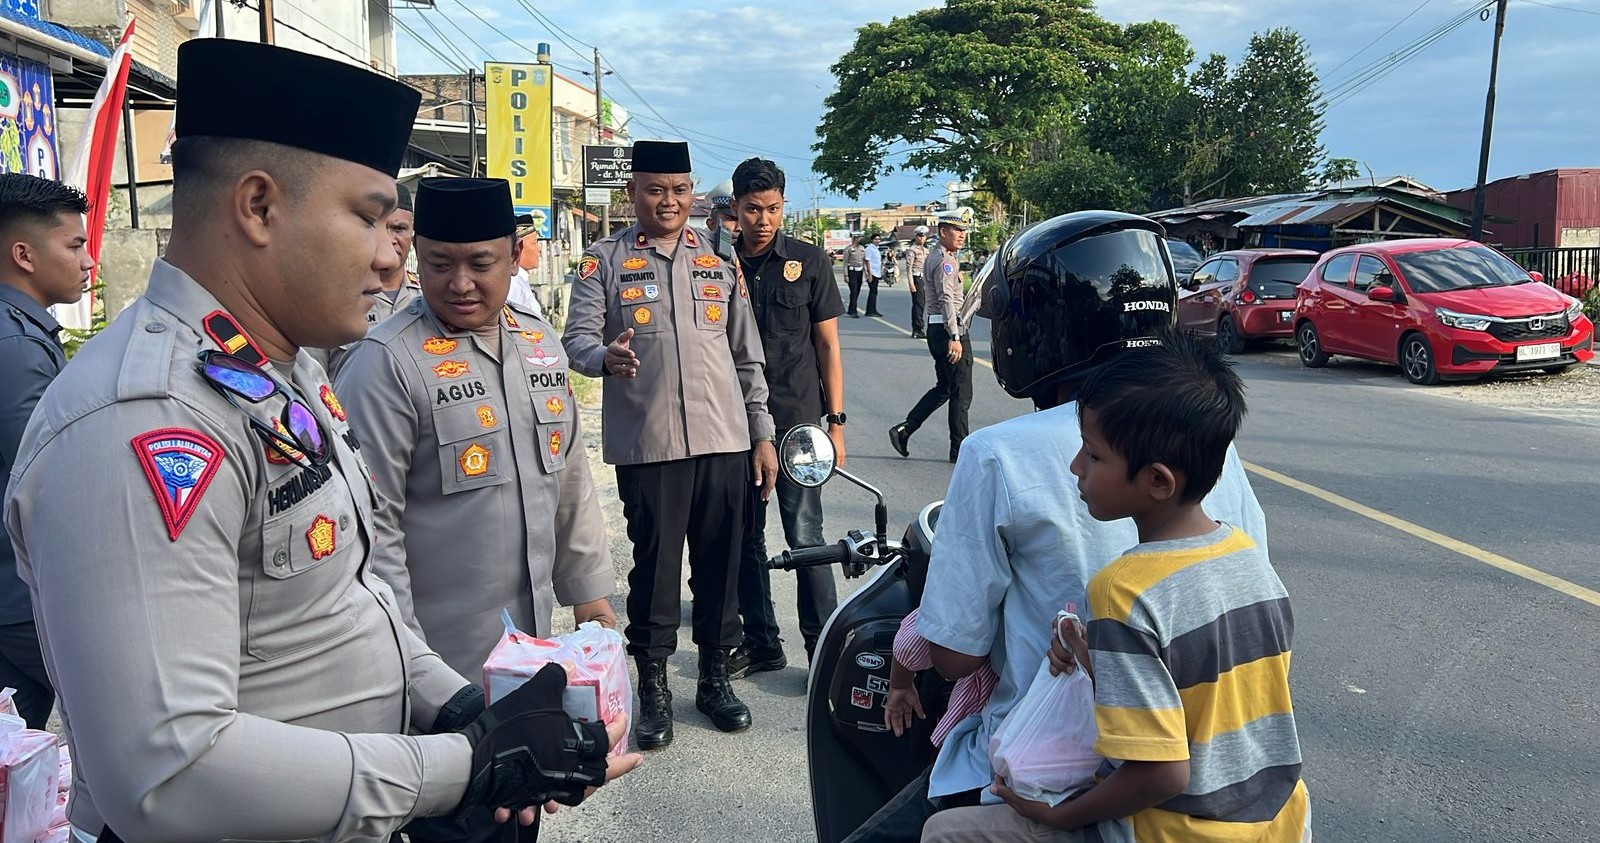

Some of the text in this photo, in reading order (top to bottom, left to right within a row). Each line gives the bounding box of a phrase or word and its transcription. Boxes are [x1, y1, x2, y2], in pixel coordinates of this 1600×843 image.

[511, 69, 527, 199] POLISI
[590, 161, 619, 171] Rumah
[692, 270, 724, 280] POLRI
[1123, 300, 1170, 313] HONDA
[529, 372, 565, 388] POLRI
[436, 381, 486, 405] AGUS
[148, 440, 171, 452] POLISI
